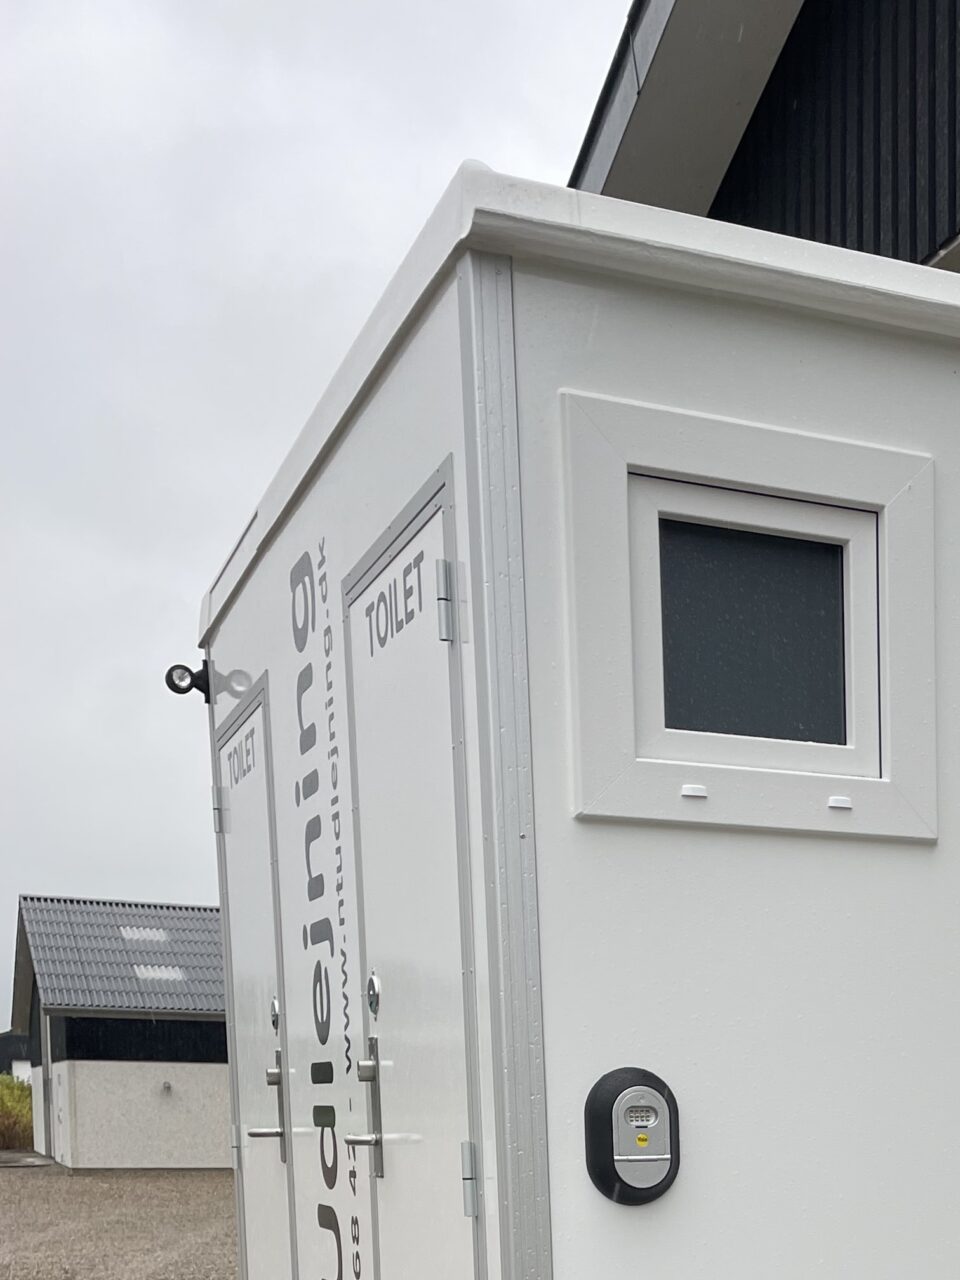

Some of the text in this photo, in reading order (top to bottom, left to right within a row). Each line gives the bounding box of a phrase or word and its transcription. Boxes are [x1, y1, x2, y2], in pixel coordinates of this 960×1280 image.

[364, 550, 425, 658] TOILET
[226, 727, 257, 790] TOILET
[317, 536, 353, 1074] www.ntudlejning.dk
[351, 1215, 361, 1280] 68
